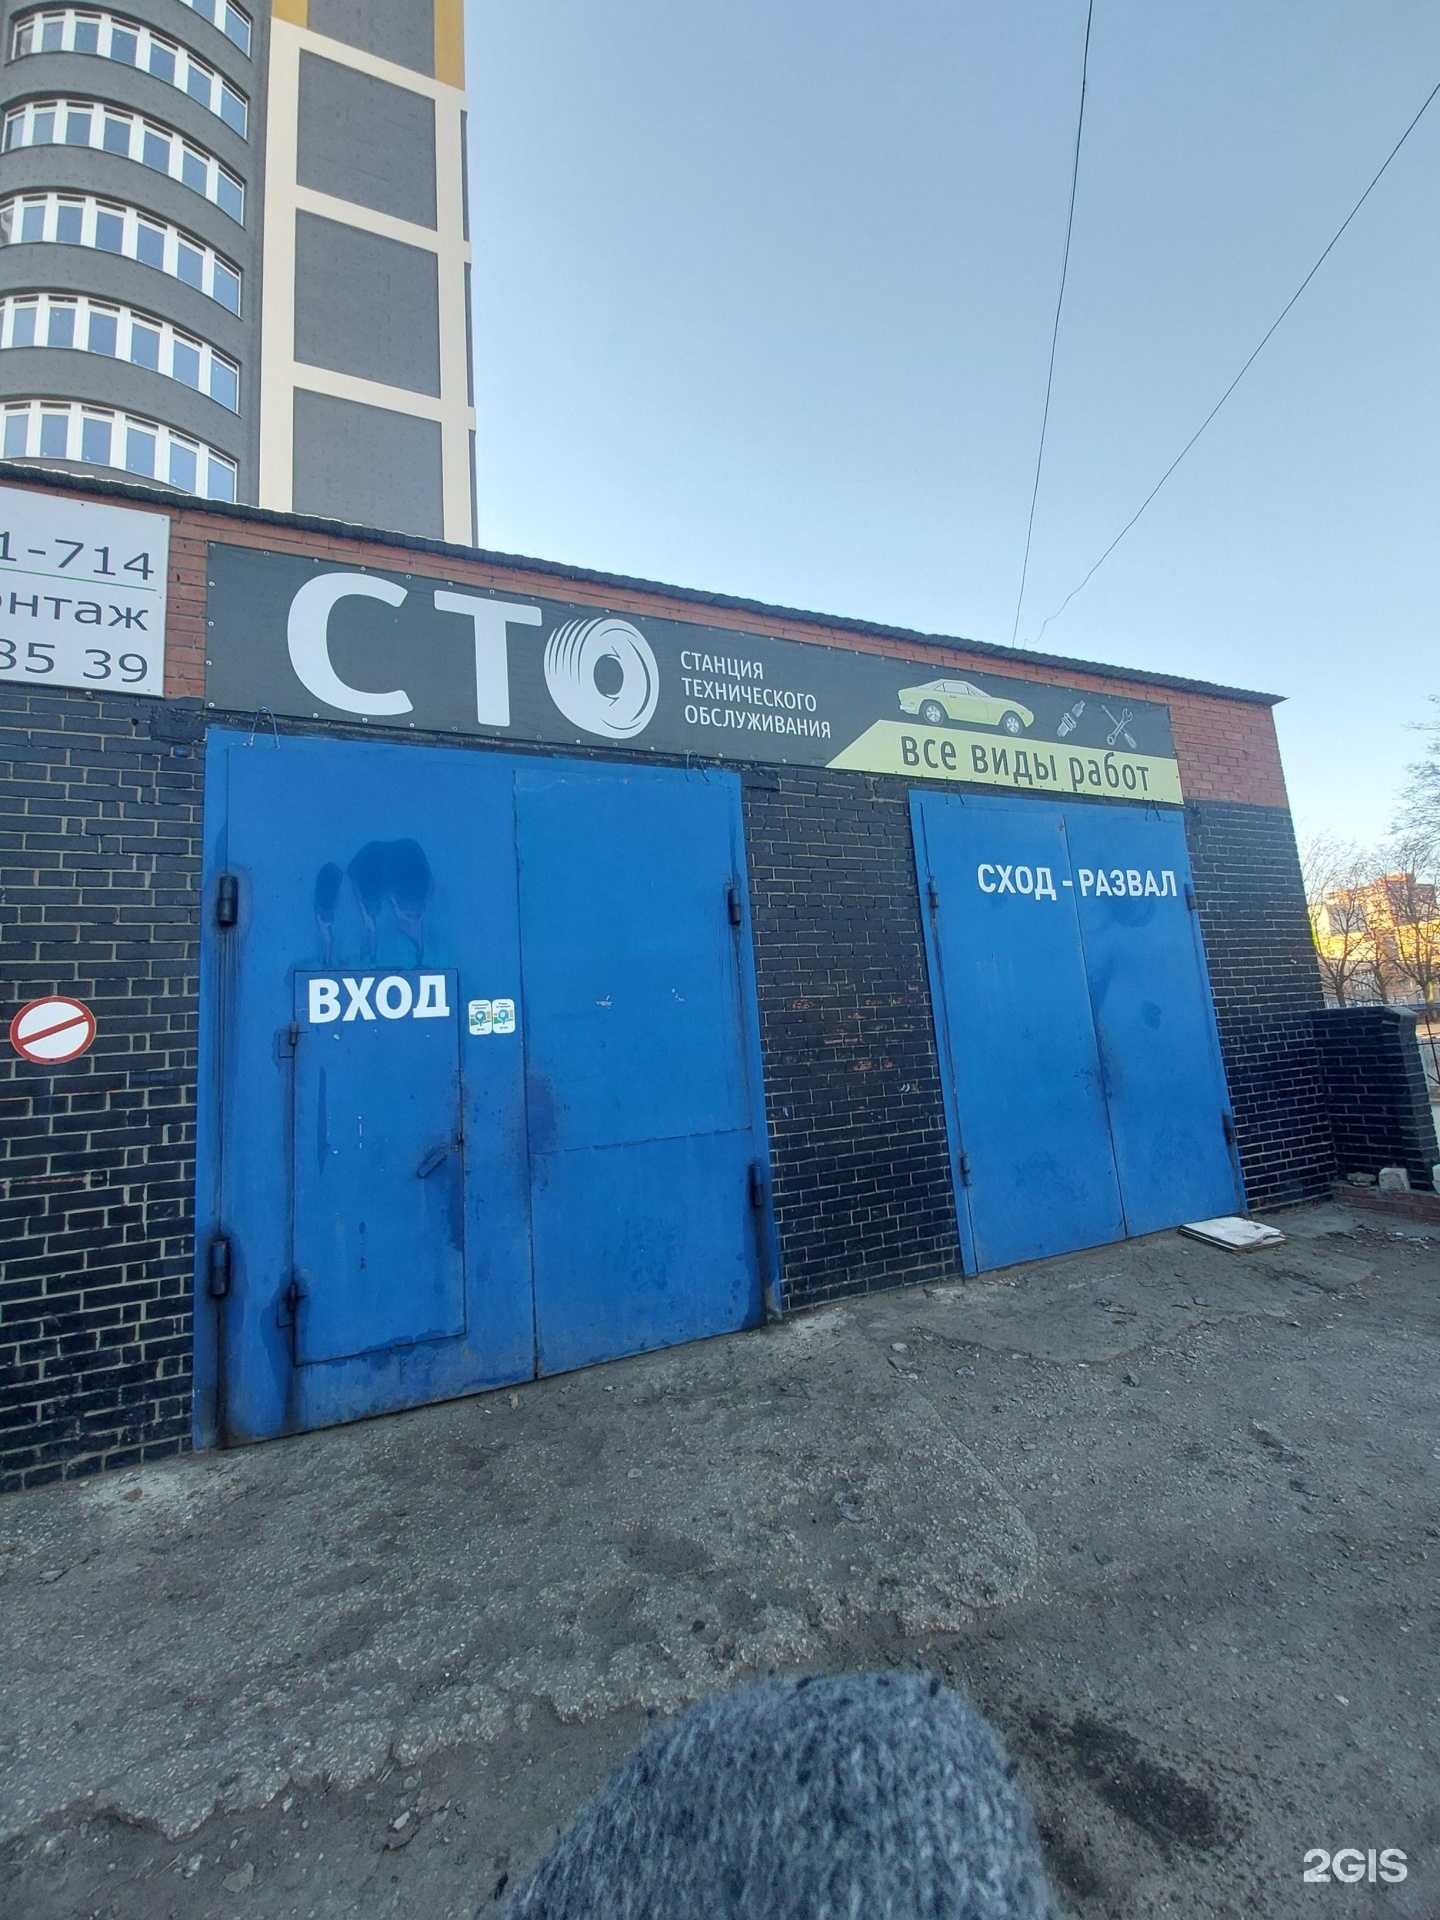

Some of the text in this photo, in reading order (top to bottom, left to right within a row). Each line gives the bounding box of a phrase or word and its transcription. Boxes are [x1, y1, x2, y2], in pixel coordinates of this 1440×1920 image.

[0, 591, 149, 632] нтаж
[83, 648, 148, 683] 39
[287, 572, 660, 740] СТО
[680, 650, 764, 681] СТАНЦИЯ
[681, 677, 817, 712] ТЕХНИЧЕСКОГО
[684, 704, 831, 739] ОБСЛУЖИВАНИЯ
[901, 735, 1149, 792] все виды работ
[308, 974, 451, 1024] ВХОД
